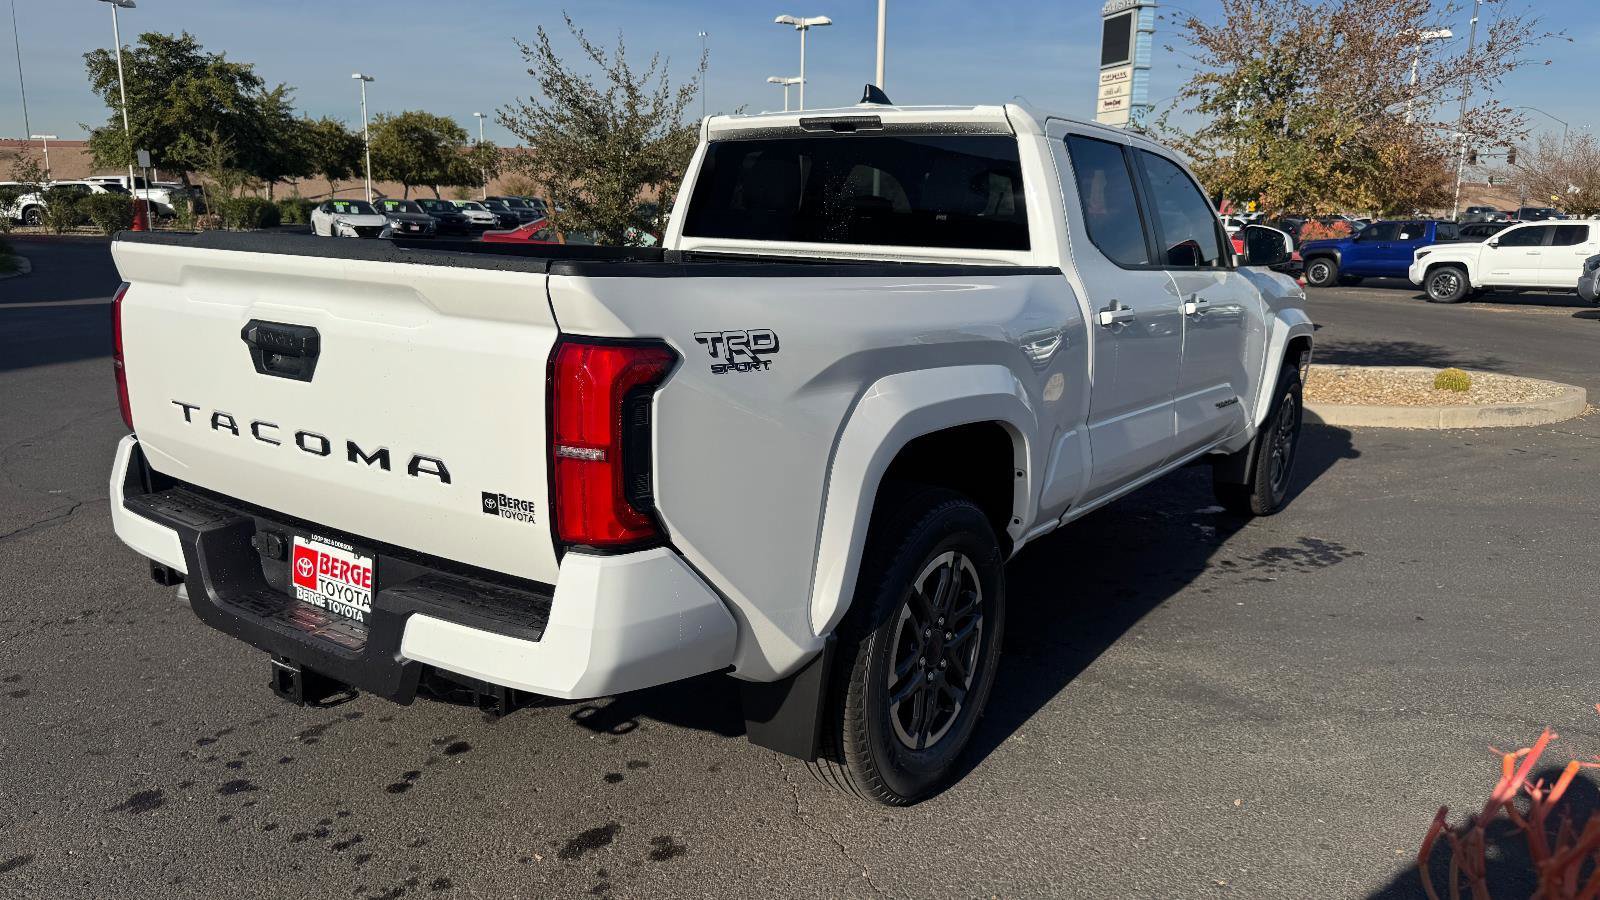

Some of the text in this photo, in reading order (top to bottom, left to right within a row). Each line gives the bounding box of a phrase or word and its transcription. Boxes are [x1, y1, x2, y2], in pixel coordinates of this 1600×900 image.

[694, 329, 780, 364] TRD
[711, 360, 772, 374] SPORT
[171, 400, 452, 485] TACOMA
[498, 493, 535, 513] BERGE
[499, 509, 536, 524] TOYOTA
[319, 552, 372, 589] BERGE
[296, 587, 364, 622] BERGE TOYOTA
[318, 578, 372, 606] TOYOTA
